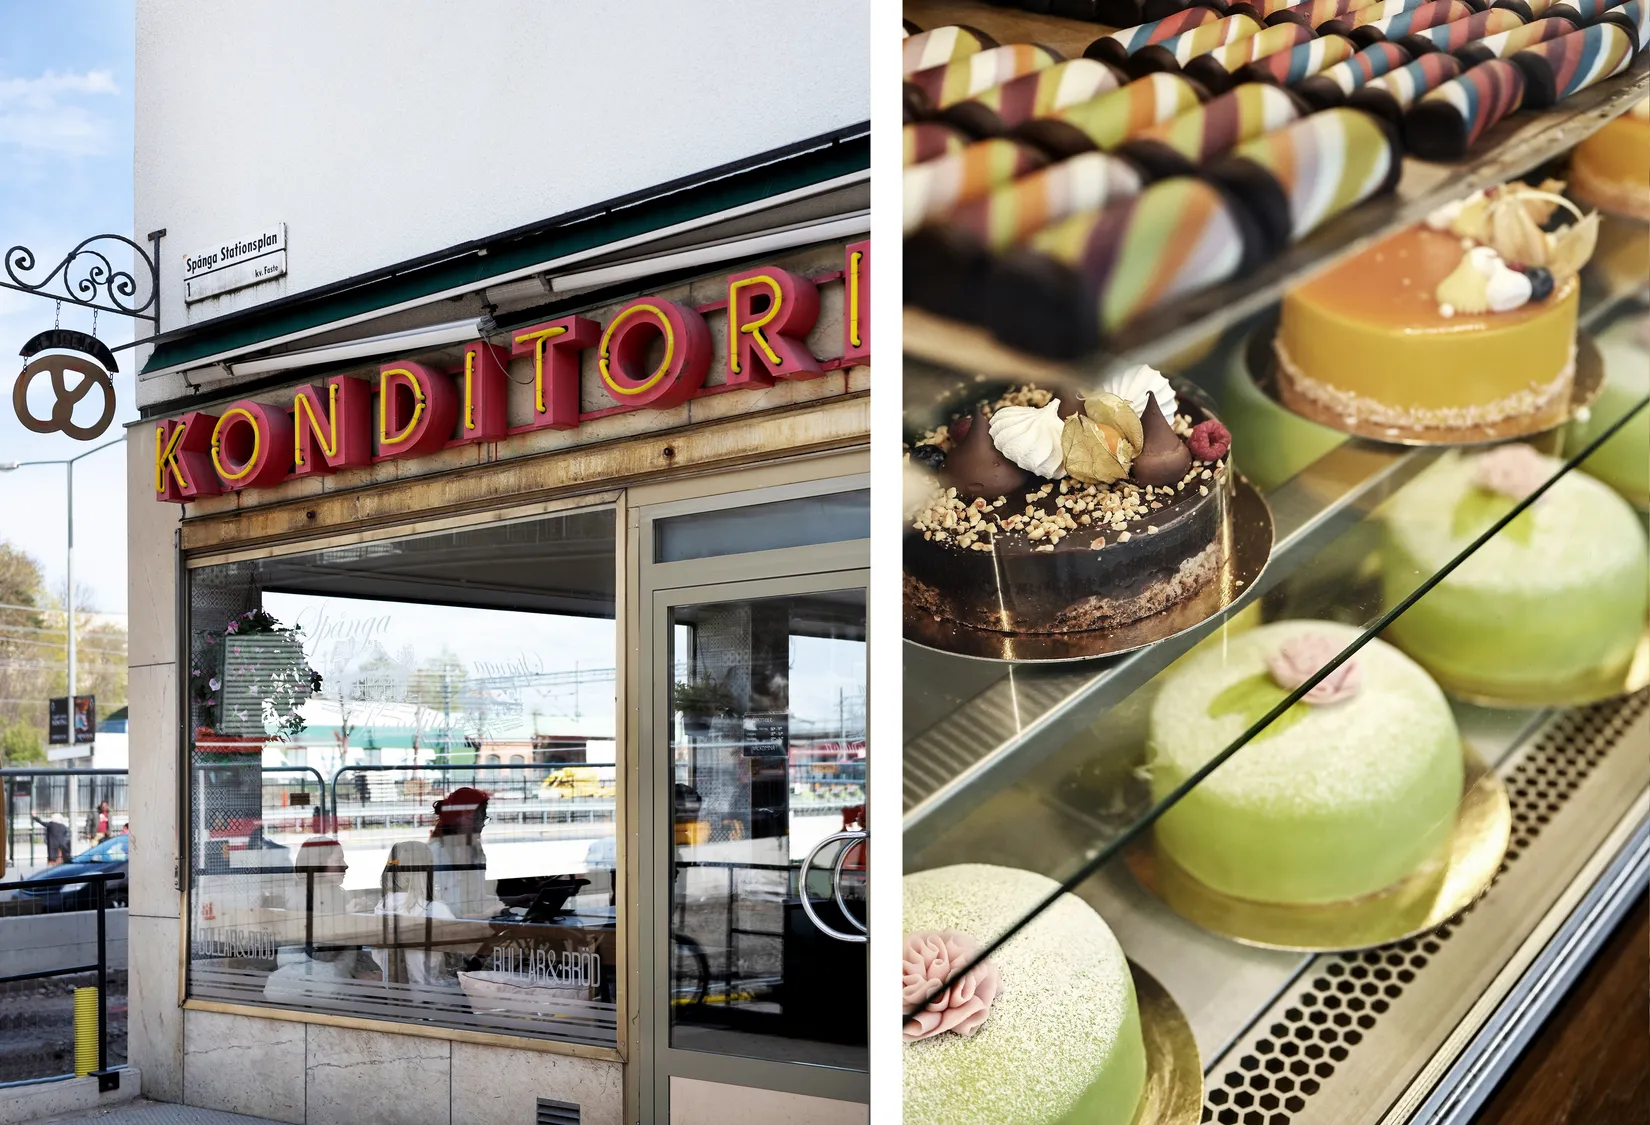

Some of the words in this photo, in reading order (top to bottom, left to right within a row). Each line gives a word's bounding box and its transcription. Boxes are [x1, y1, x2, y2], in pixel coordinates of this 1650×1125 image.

[186, 254, 217, 274] Spånga
[220, 233, 277, 261] Stationsplan
[255, 269, 264, 278] kv.
[264, 265, 279, 275] Faste
[187, 282, 191, 297] 1
[155, 239, 870, 504] KONDITORI
[295, 598, 391, 656] Spånga
[199, 927, 275, 960] BULLAR&BRÖD
[493, 946, 601, 988] BULLAR&BRÖD
